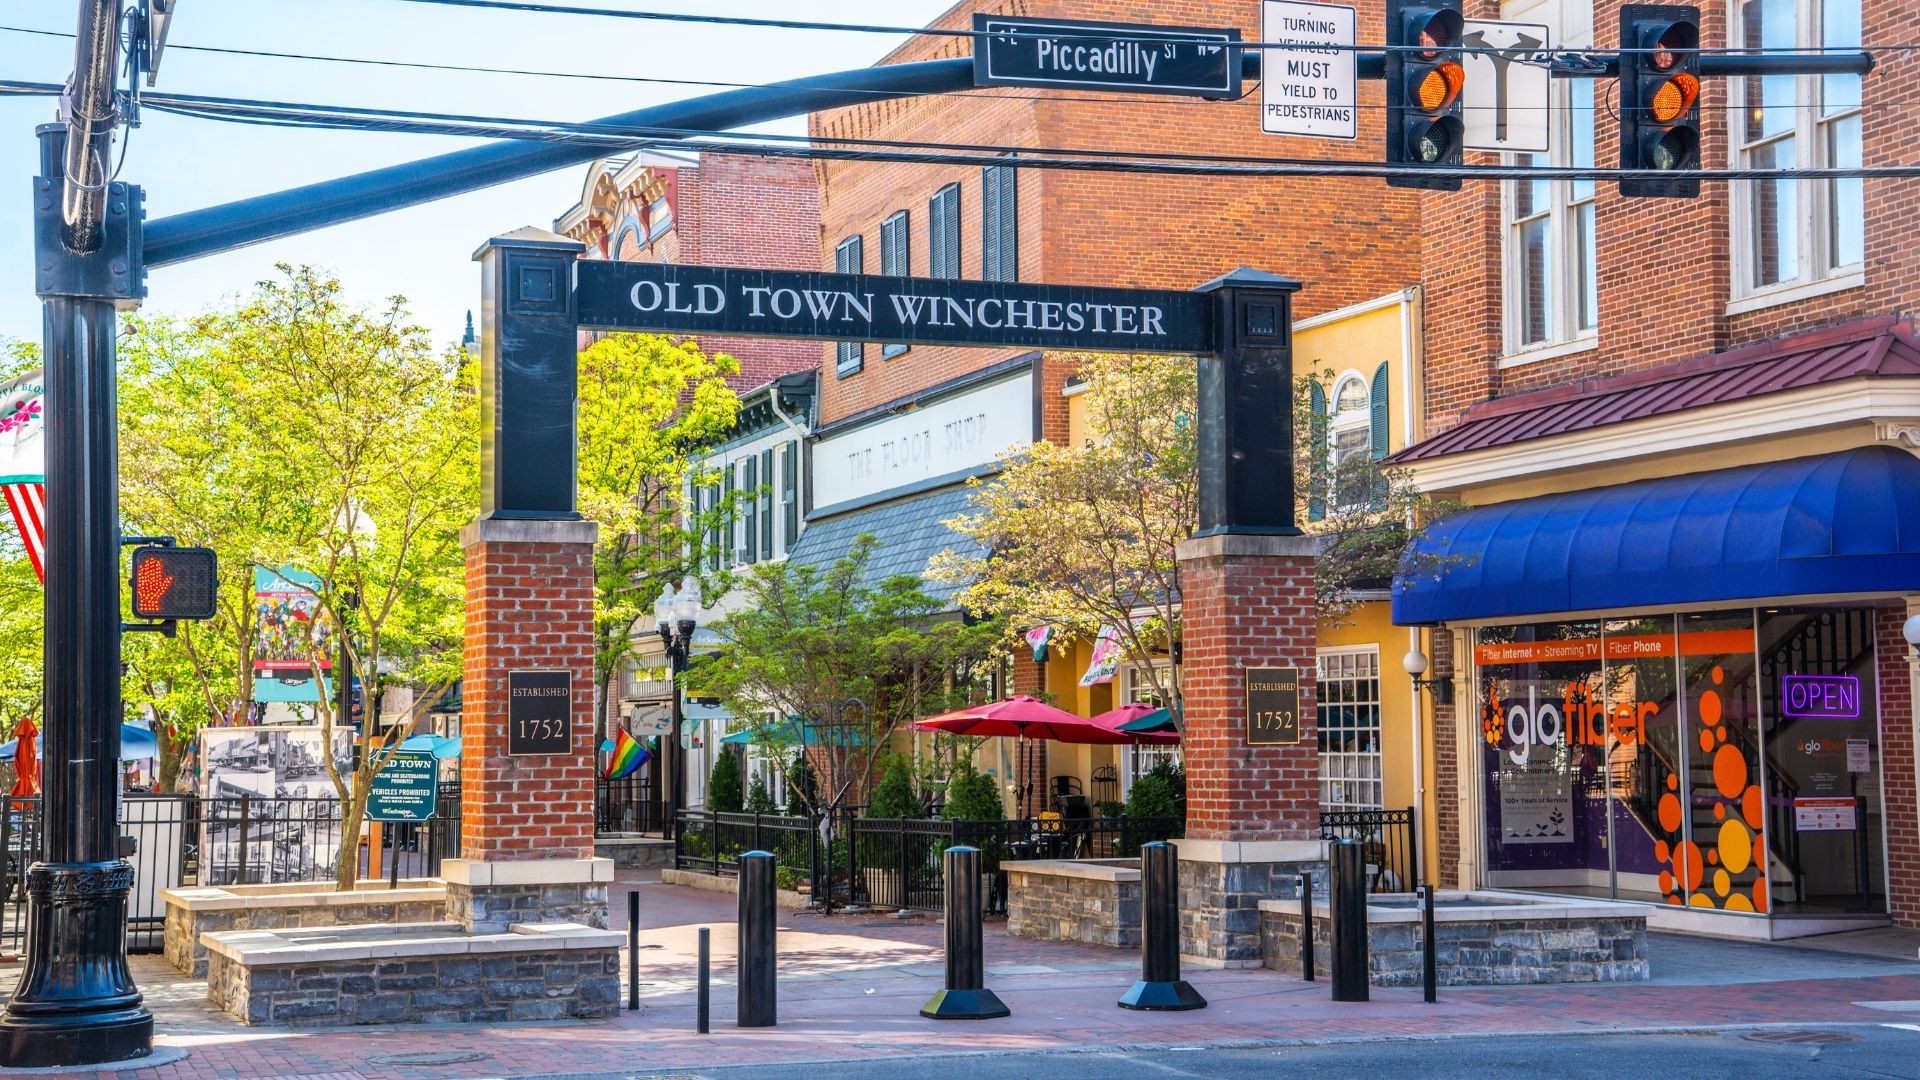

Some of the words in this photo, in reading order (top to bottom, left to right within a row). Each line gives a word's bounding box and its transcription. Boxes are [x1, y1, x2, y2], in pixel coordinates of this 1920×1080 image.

[1282, 18, 1336, 34] TURNING
[1010, 28, 1018, 45] E
[1037, 38, 1157, 82] Piccadilly
[1280, 38, 1339, 56] VEHICLES
[1288, 60, 1330, 78] MUST
[1282, 84, 1316, 98] YIELD
[1323, 87, 1338, 100] TO
[1268, 104, 1350, 122] PEDESTRIANS
[630, 280, 726, 314] OLD
[742, 286, 874, 322] TOWN
[890, 294, 1166, 335] WINCHESTER
[1482, 649, 1500, 660] Fiber
[1502, 647, 1532, 658] Internet
[1544, 644, 1584, 657] Streaming
[1586, 644, 1598, 654] TV
[1610, 642, 1632, 654] Fiber
[1633, 640, 1662, 652] Phone
[513, 688, 568, 696] ESTABLISHED
[1250, 682, 1296, 691] ESTABLISHED
[1792, 683, 1853, 710] OPEN
[1256, 711, 1292, 730] 1752
[520, 720, 564, 740] 1752
[400, 760, 432, 768] TOWN
